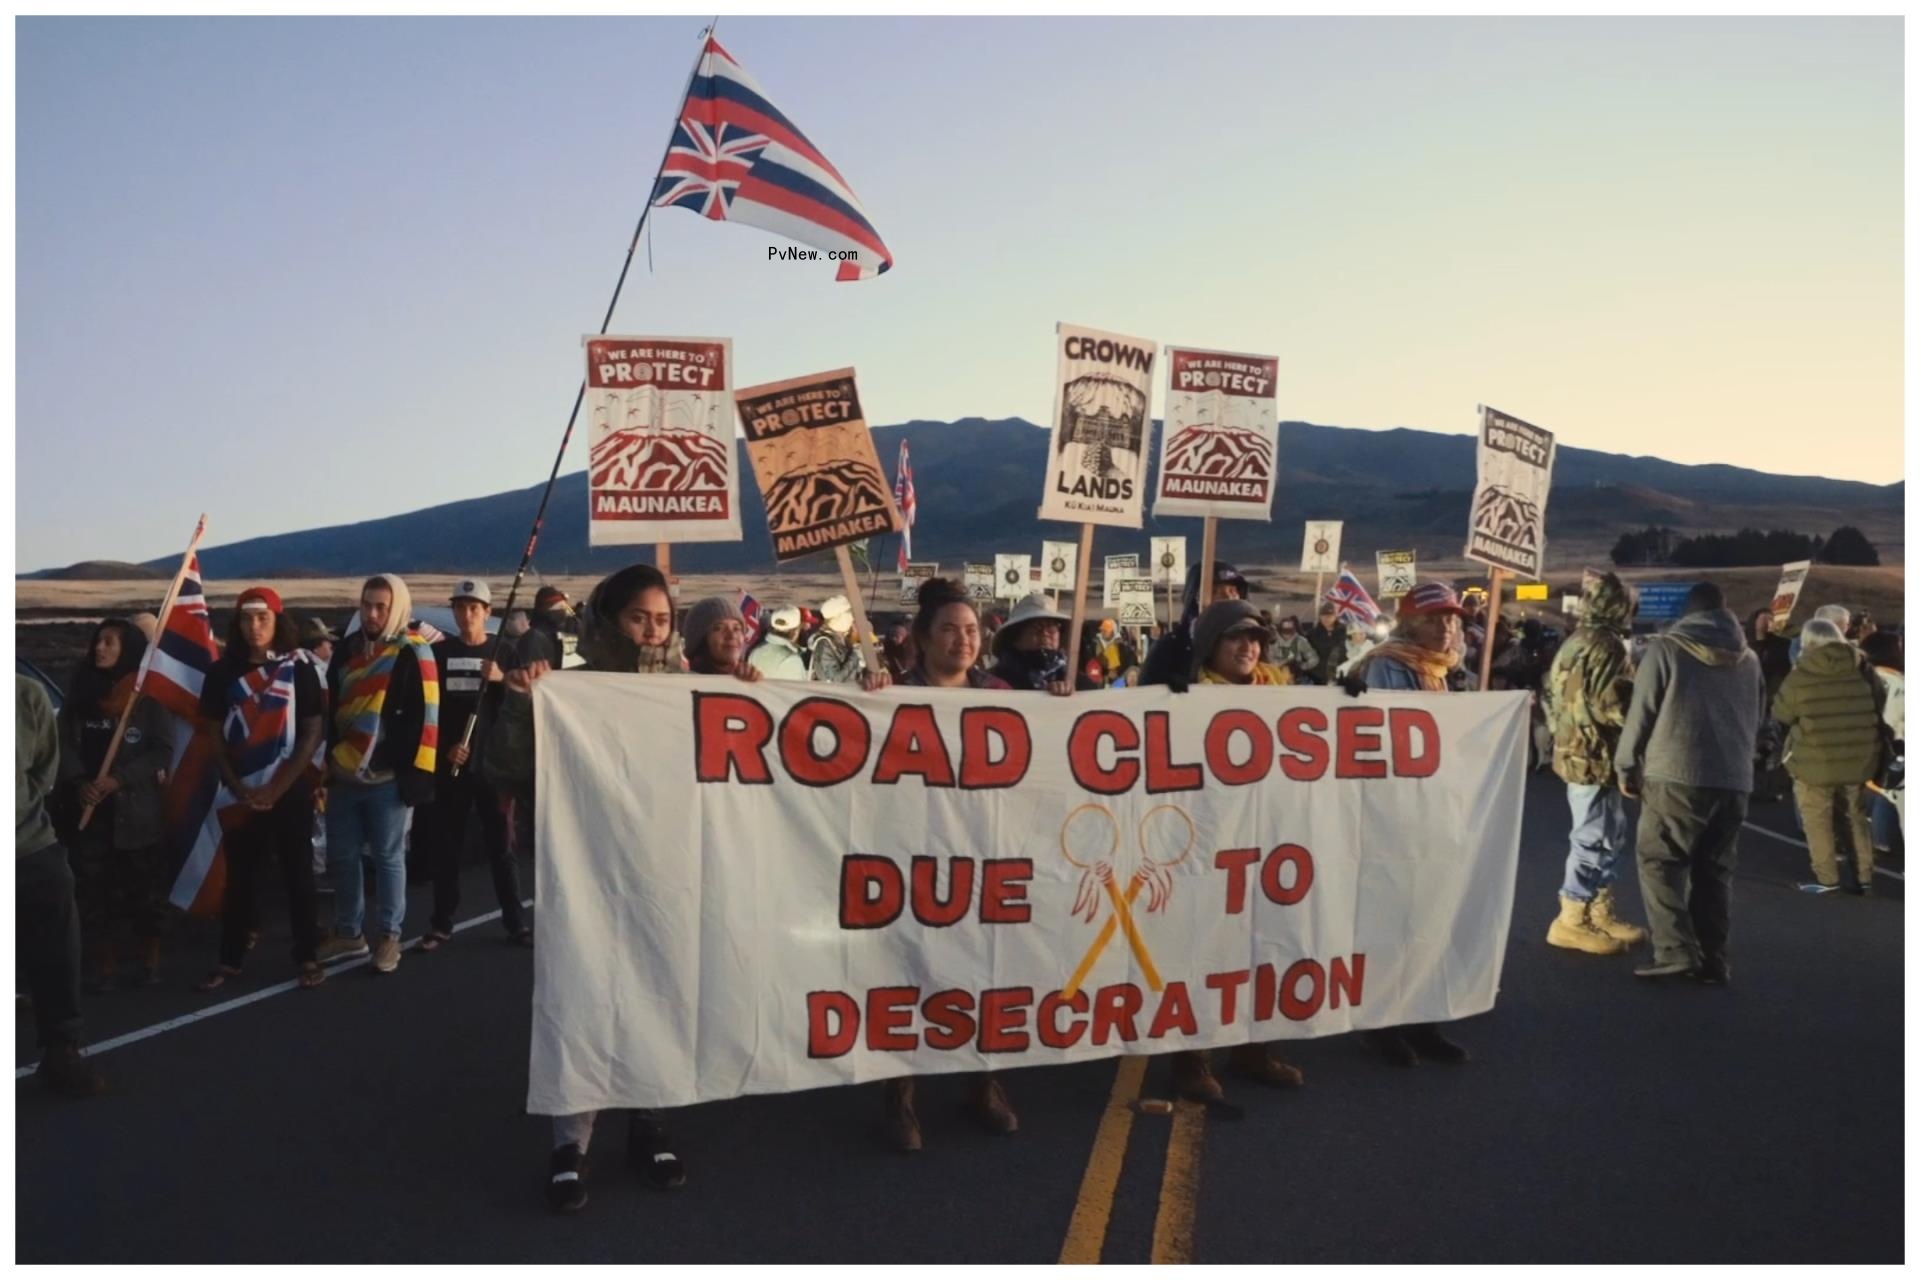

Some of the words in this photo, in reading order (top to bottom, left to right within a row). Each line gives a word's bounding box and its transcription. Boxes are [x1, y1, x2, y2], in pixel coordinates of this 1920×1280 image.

[608, 350, 627, 361] WE
[630, 348, 653, 359] ARE
[656, 349, 687, 361] HERE
[688, 352, 705, 363] TO
[1064, 336, 1153, 374] CROWN
[1186, 359, 1202, 369] WE
[1204, 359, 1222, 369] ARE
[1224, 360, 1248, 372] HERE
[1248, 365, 1262, 375] TO
[599, 362, 714, 386] PROTECT
[1180, 371, 1268, 394] PROTECT
[756, 401, 772, 414] WE
[773, 395, 794, 408] ARE
[797, 390, 824, 403] HERE
[825, 388, 841, 399] TO
[752, 401, 850, 436] PROTECT
[1056, 471, 1133, 500] LANDS
[1166, 478, 1263, 497] MAUNAKEA
[597, 495, 723, 513] MAUNAKEA
[777, 513, 888, 553] MAUNAKEA
[1475, 536, 1536, 569] MAUNAKEA
[692, 691, 1032, 790] ROAD
[1068, 707, 1440, 795] CLOSED
[839, 854, 1033, 931] DUE
[1214, 842, 1314, 916] TO
[807, 953, 1365, 1058] DESECRATION
